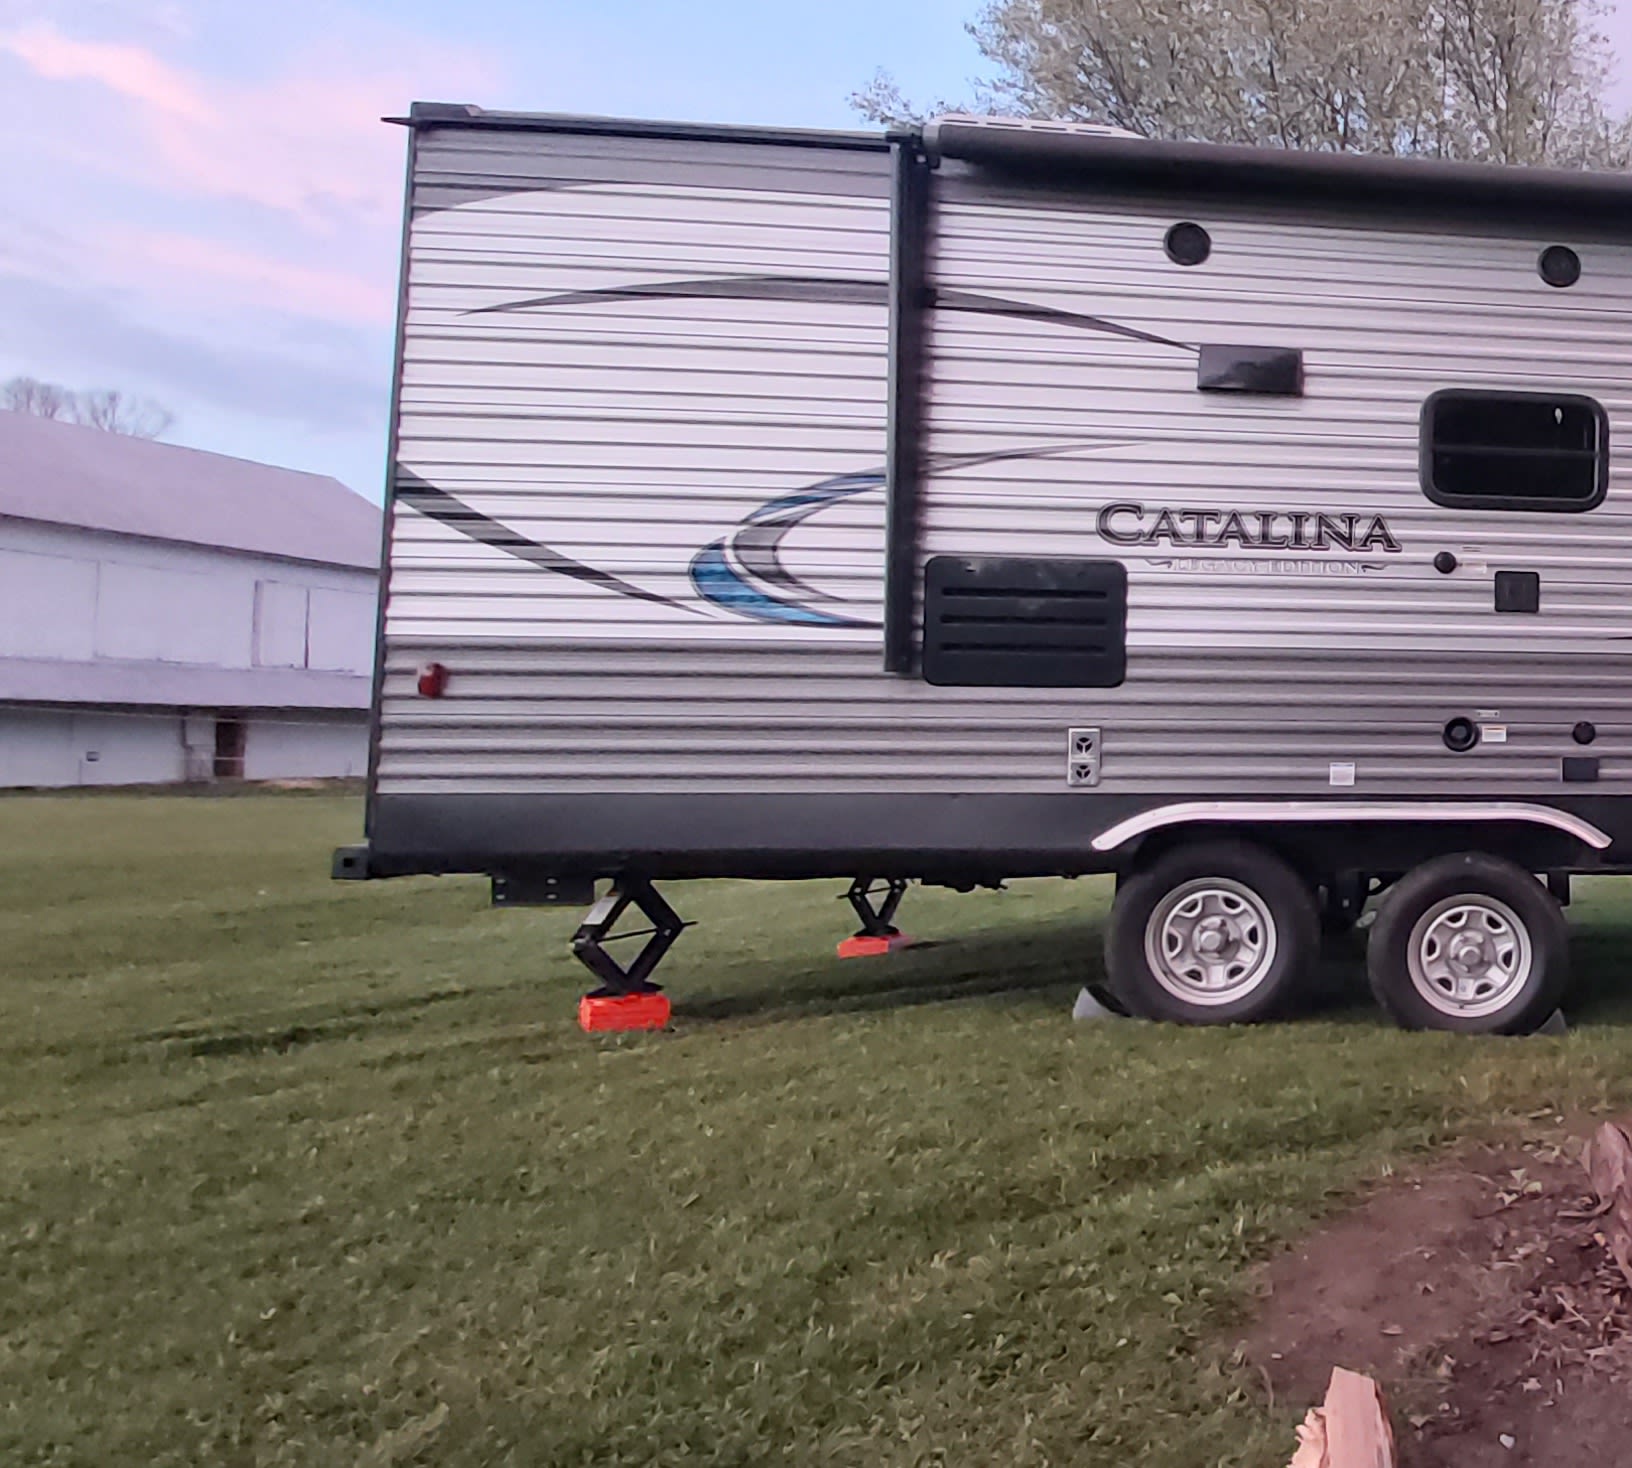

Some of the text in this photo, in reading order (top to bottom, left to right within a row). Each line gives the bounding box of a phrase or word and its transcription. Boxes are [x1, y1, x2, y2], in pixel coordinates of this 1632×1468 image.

[1096, 501, 1402, 552] CATALINA
[1173, 558, 1361, 575] LEGACY EDITION
